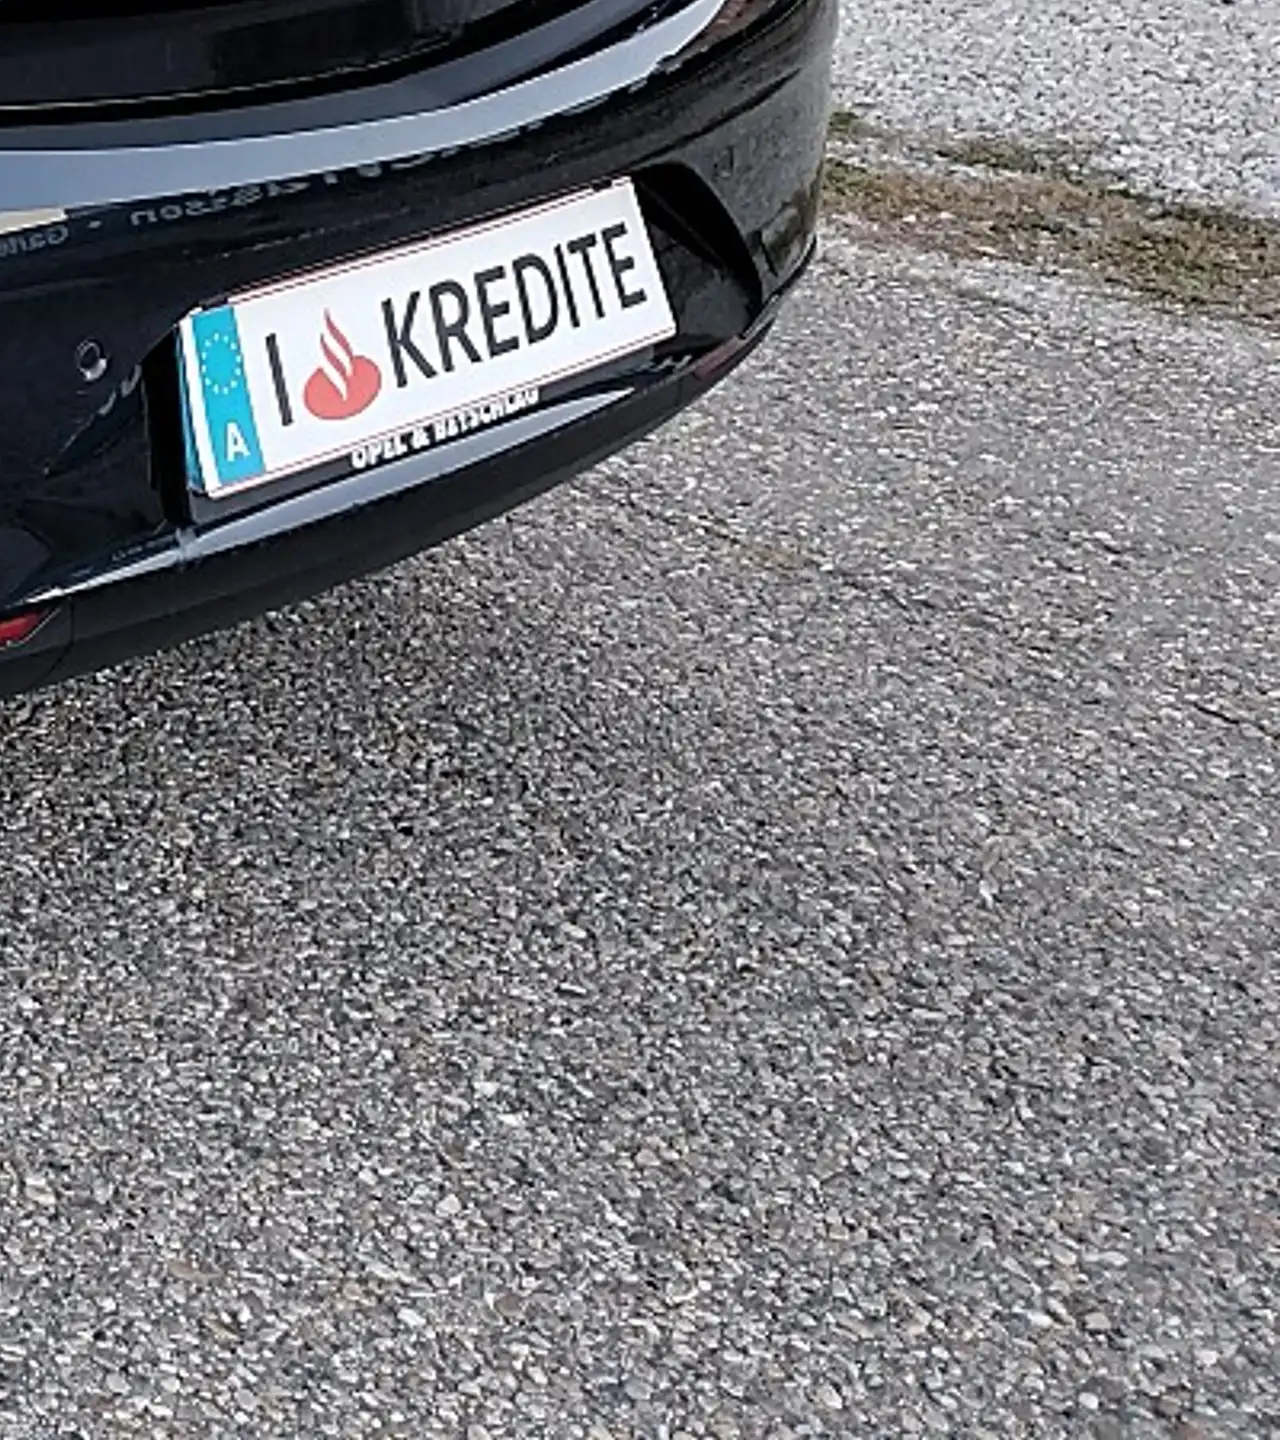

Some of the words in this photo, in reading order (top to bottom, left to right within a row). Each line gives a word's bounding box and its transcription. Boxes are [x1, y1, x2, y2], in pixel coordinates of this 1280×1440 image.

[265, 332, 293, 427] I
[381, 222, 647, 389] KREDITE
[226, 421, 250, 461] A
[351, 434, 407, 469] OPEL
[410, 427, 430, 449] &
